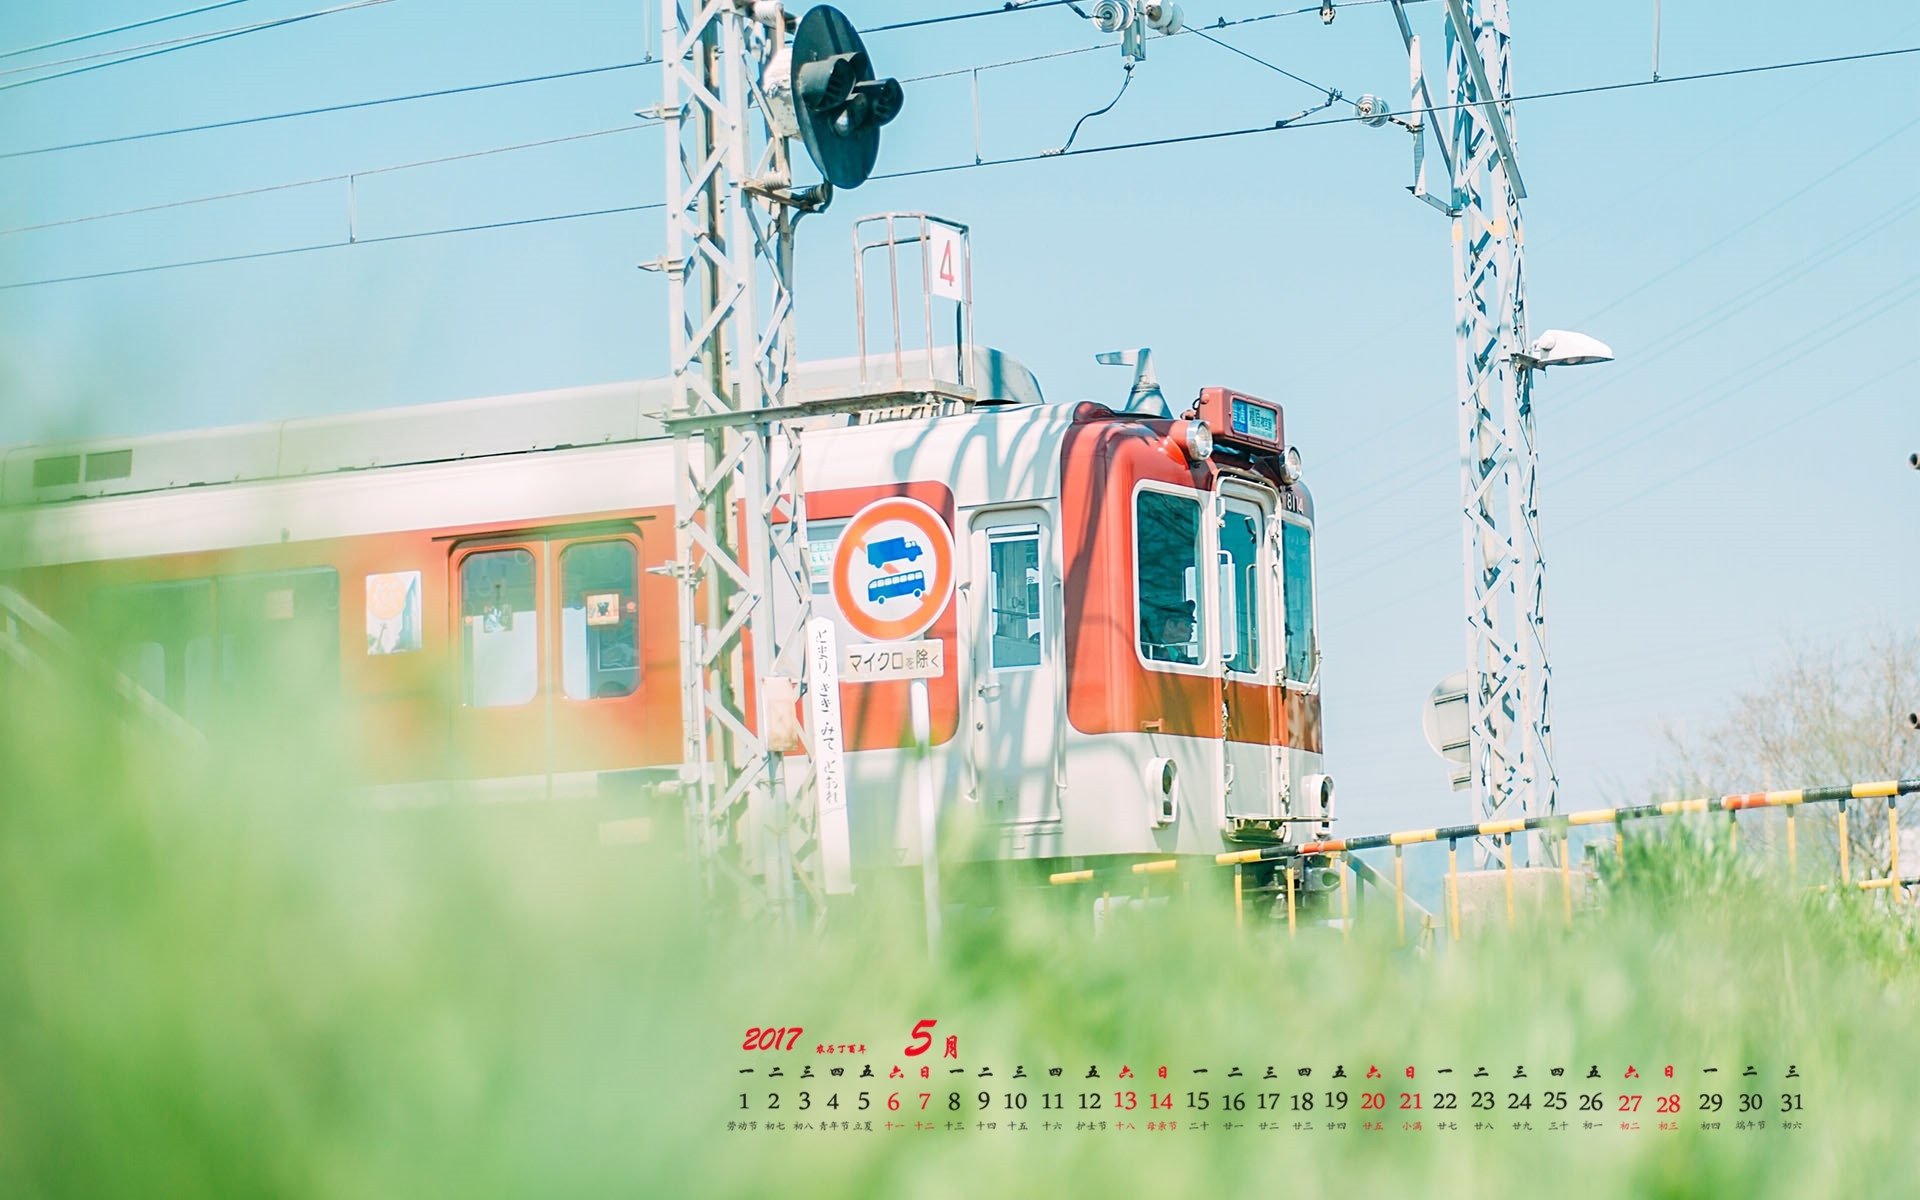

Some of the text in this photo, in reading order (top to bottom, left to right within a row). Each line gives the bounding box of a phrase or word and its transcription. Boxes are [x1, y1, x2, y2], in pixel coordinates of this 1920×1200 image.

[940, 239, 955, 287] 4
[849, 648, 939, 673] マイクロを除く
